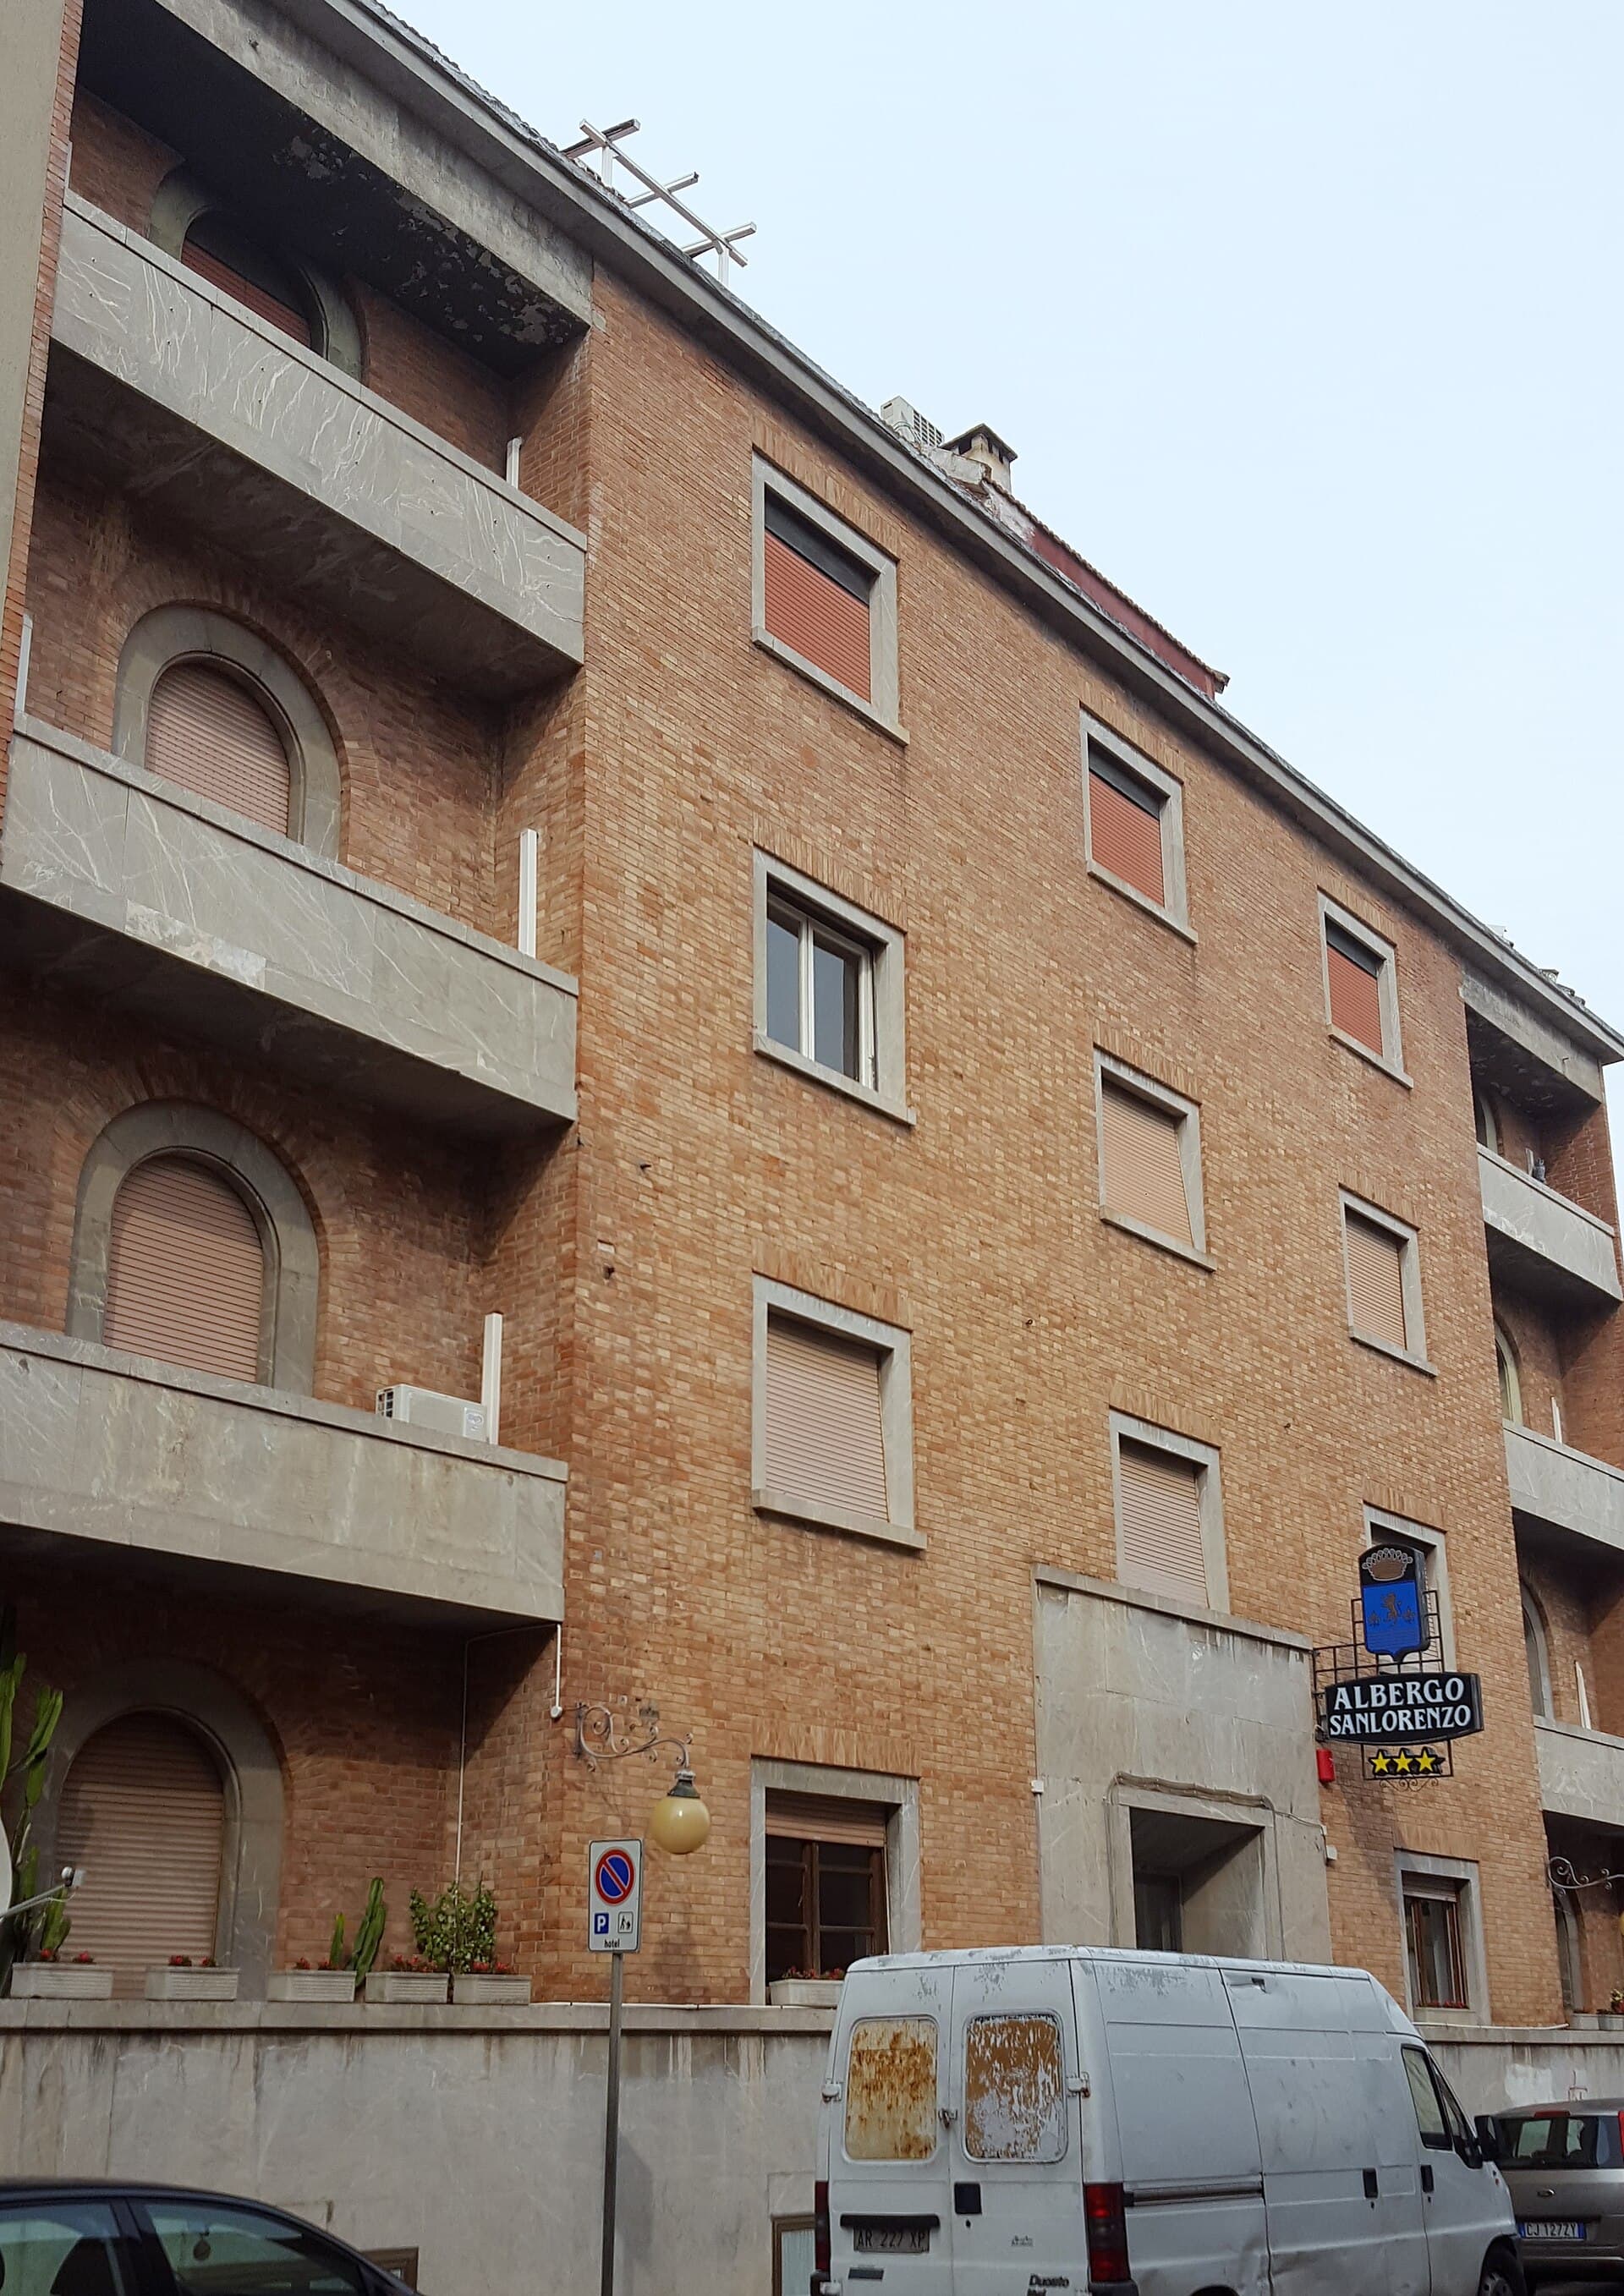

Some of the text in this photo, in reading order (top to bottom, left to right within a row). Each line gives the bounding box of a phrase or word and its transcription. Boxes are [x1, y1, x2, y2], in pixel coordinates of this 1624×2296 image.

[1334, 1678, 1464, 1710] ALBERGO
[1330, 1705, 1471, 1735] SANLORENZO
[597, 1915, 606, 1932] P
[604, 1938, 620, 1948] hotel
